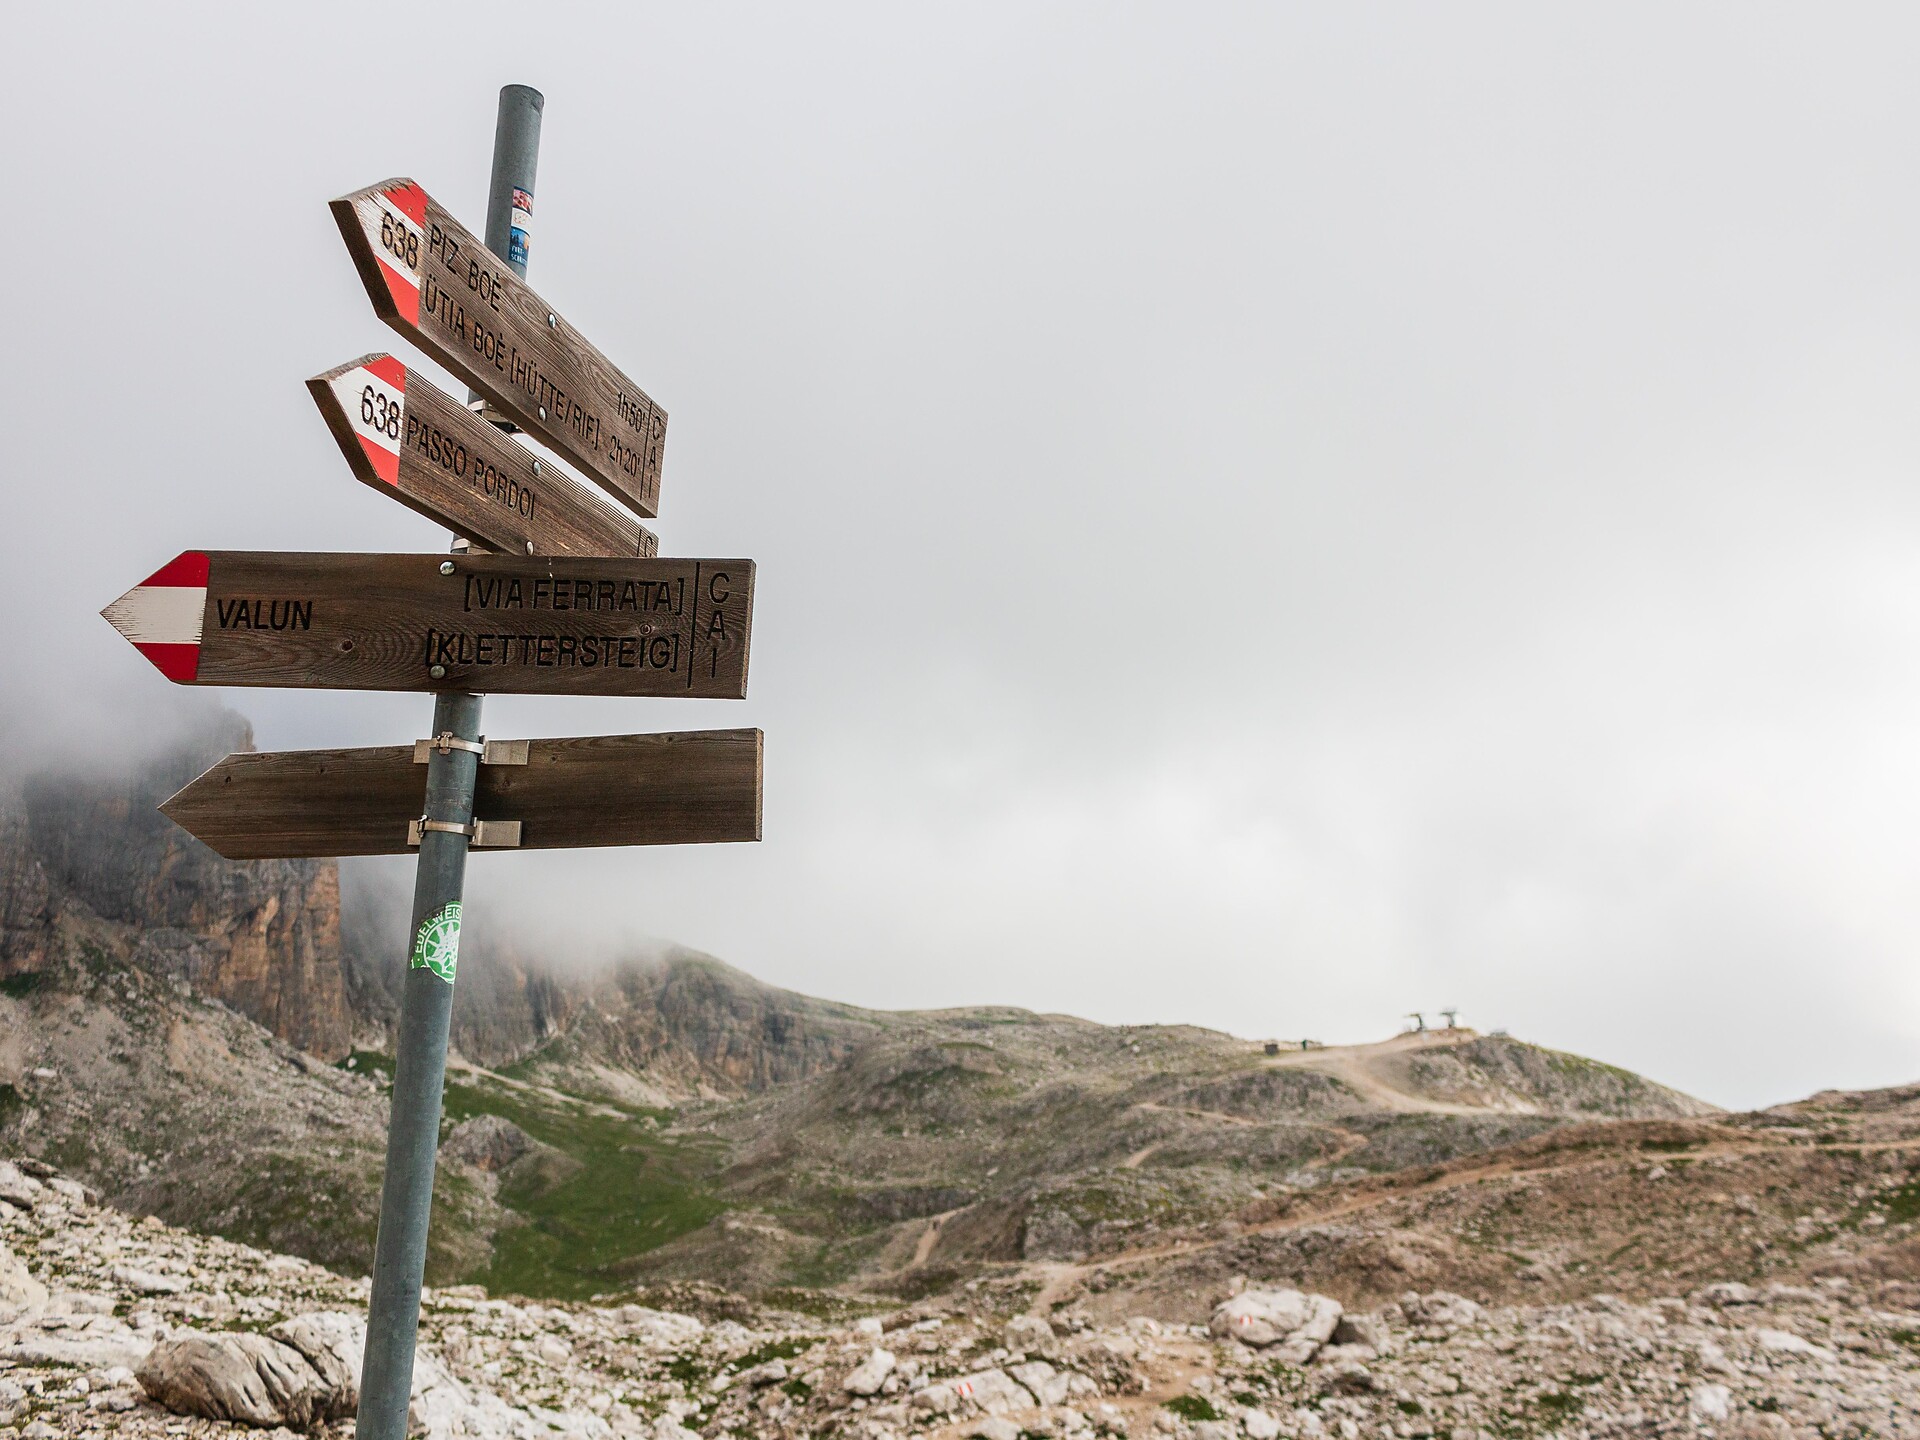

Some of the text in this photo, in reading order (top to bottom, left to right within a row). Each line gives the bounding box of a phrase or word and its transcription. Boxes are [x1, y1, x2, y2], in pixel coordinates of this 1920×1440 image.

[381, 212, 419, 270] 638
[429, 225, 460, 275] PIZ
[468, 260, 502, 312] BOÈ
[424, 274, 465, 340] ÜTIA
[474, 322, 506, 372] BOÈ
[361, 384, 400, 441] 638
[406, 414, 536, 521] PASSO PORDOI
[217, 599, 313, 630] VALUN
[464, 574, 684, 615] [VIA FERRATA]
[425, 629, 678, 673] [KLETTERSTEIG]
